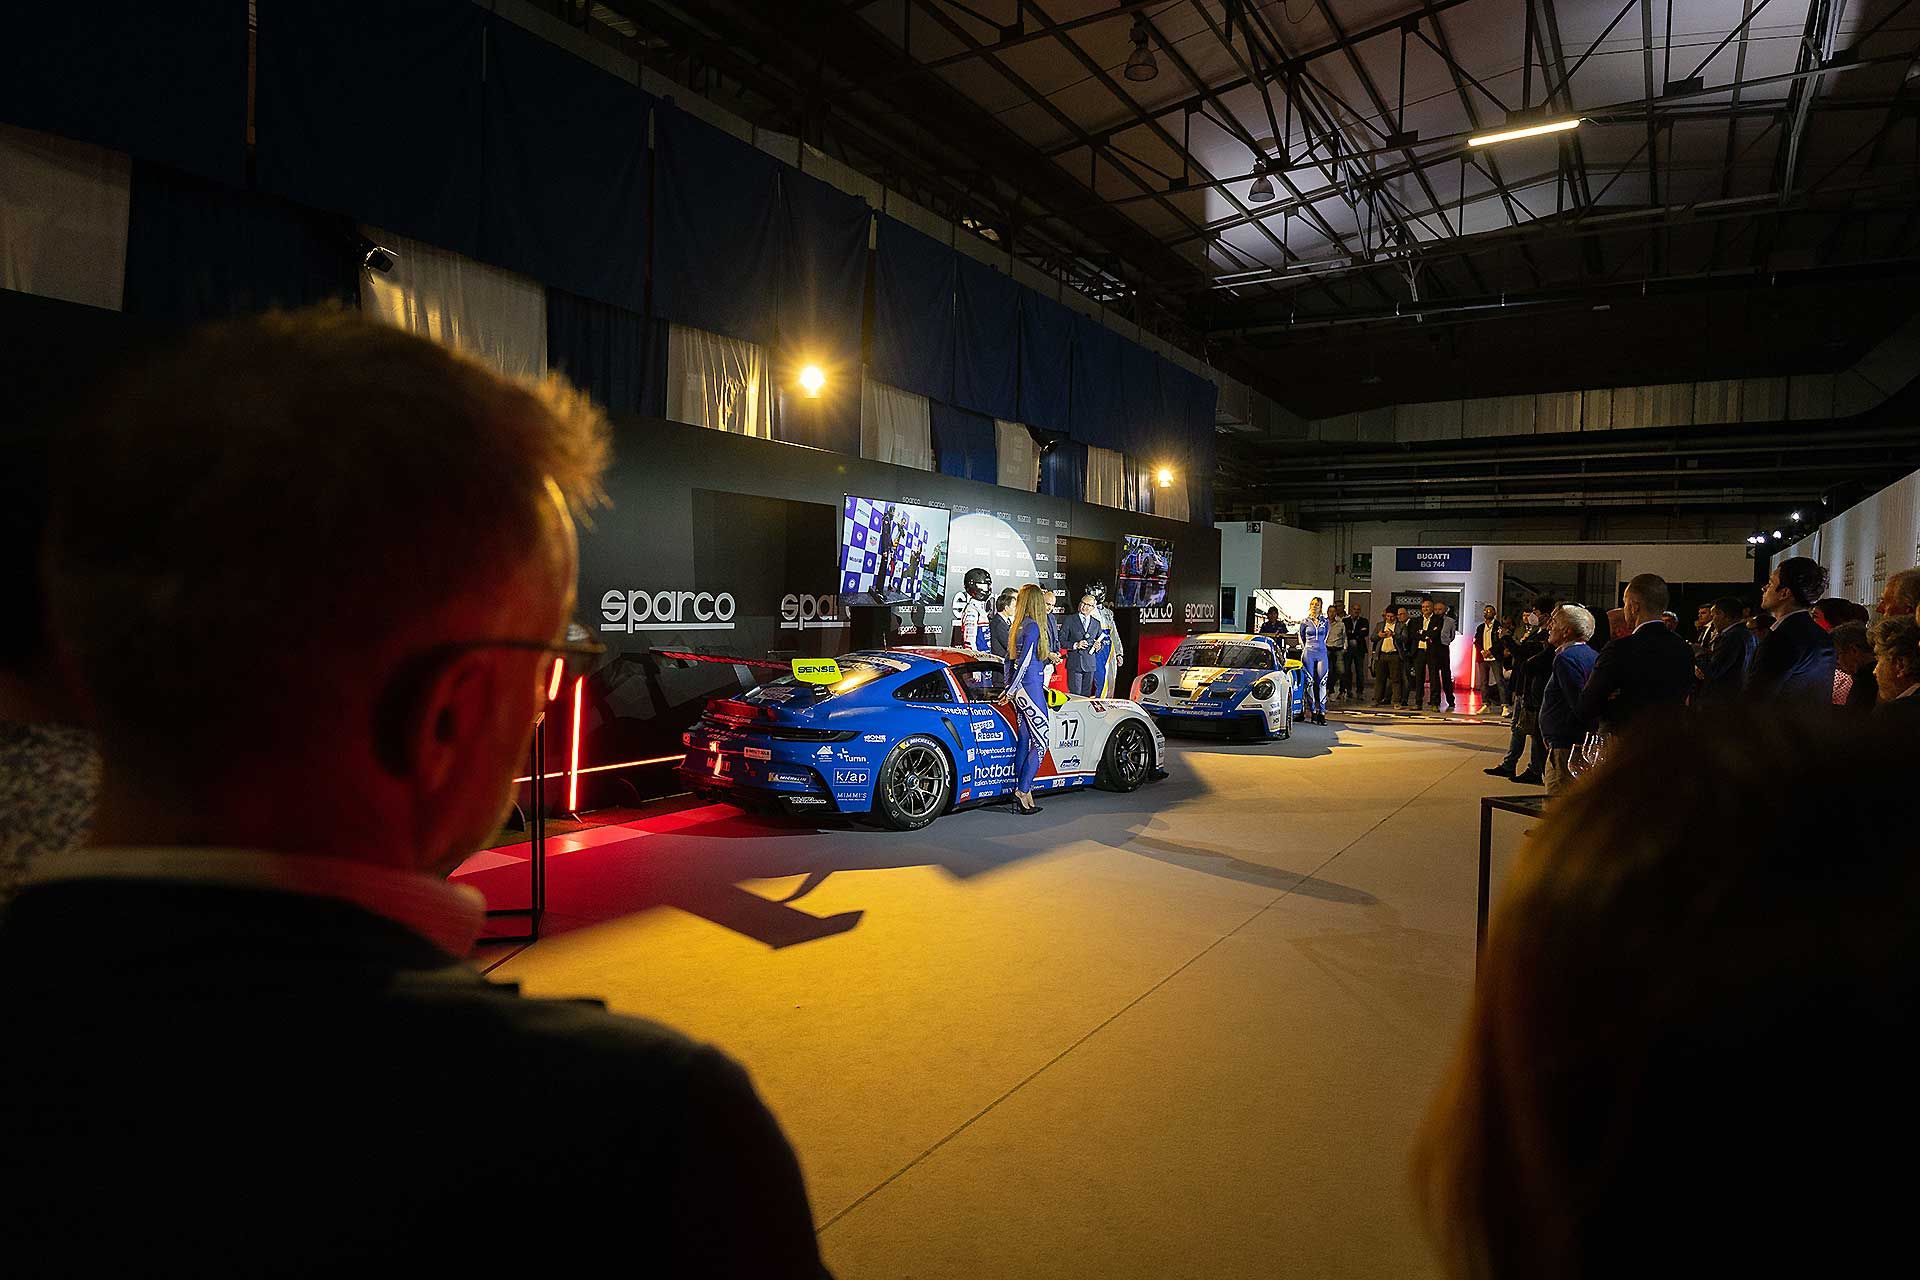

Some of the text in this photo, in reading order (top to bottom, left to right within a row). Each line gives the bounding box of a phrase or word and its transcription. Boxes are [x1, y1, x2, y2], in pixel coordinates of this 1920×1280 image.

[601, 589, 736, 634] sparco
[1184, 602, 1215, 624] sparco
[797, 665, 836, 674] SENSE
[969, 708, 994, 717] Torino
[1061, 719, 1079, 740] 17
[836, 770, 867, 784] k/ap
